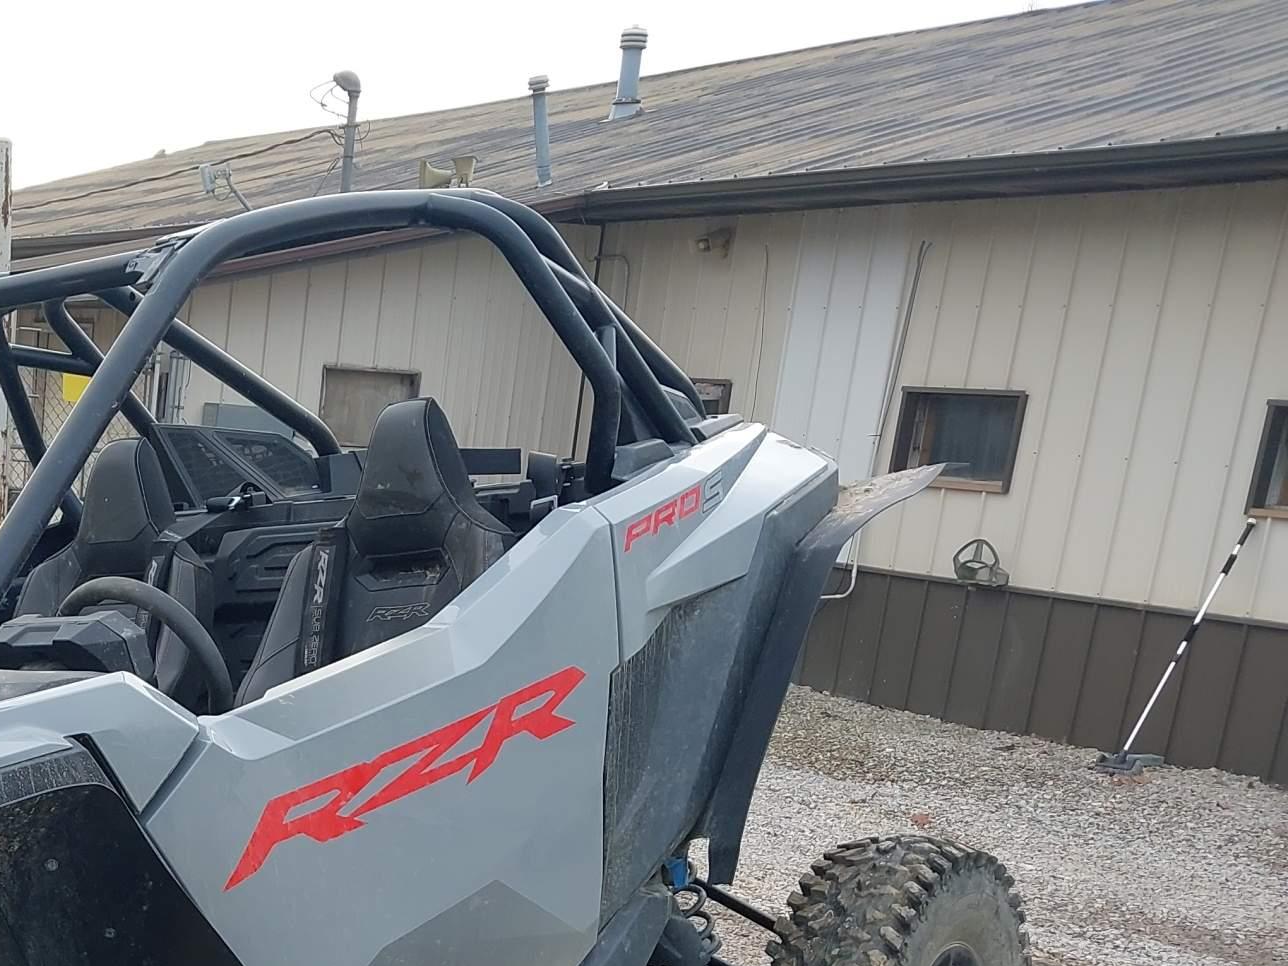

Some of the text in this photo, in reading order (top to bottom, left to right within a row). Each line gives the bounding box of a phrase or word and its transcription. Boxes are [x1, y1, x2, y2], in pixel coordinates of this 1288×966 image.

[623, 482, 702, 553] PRO
[366, 602, 431, 622] RZR
[223, 665, 587, 892] RZR
